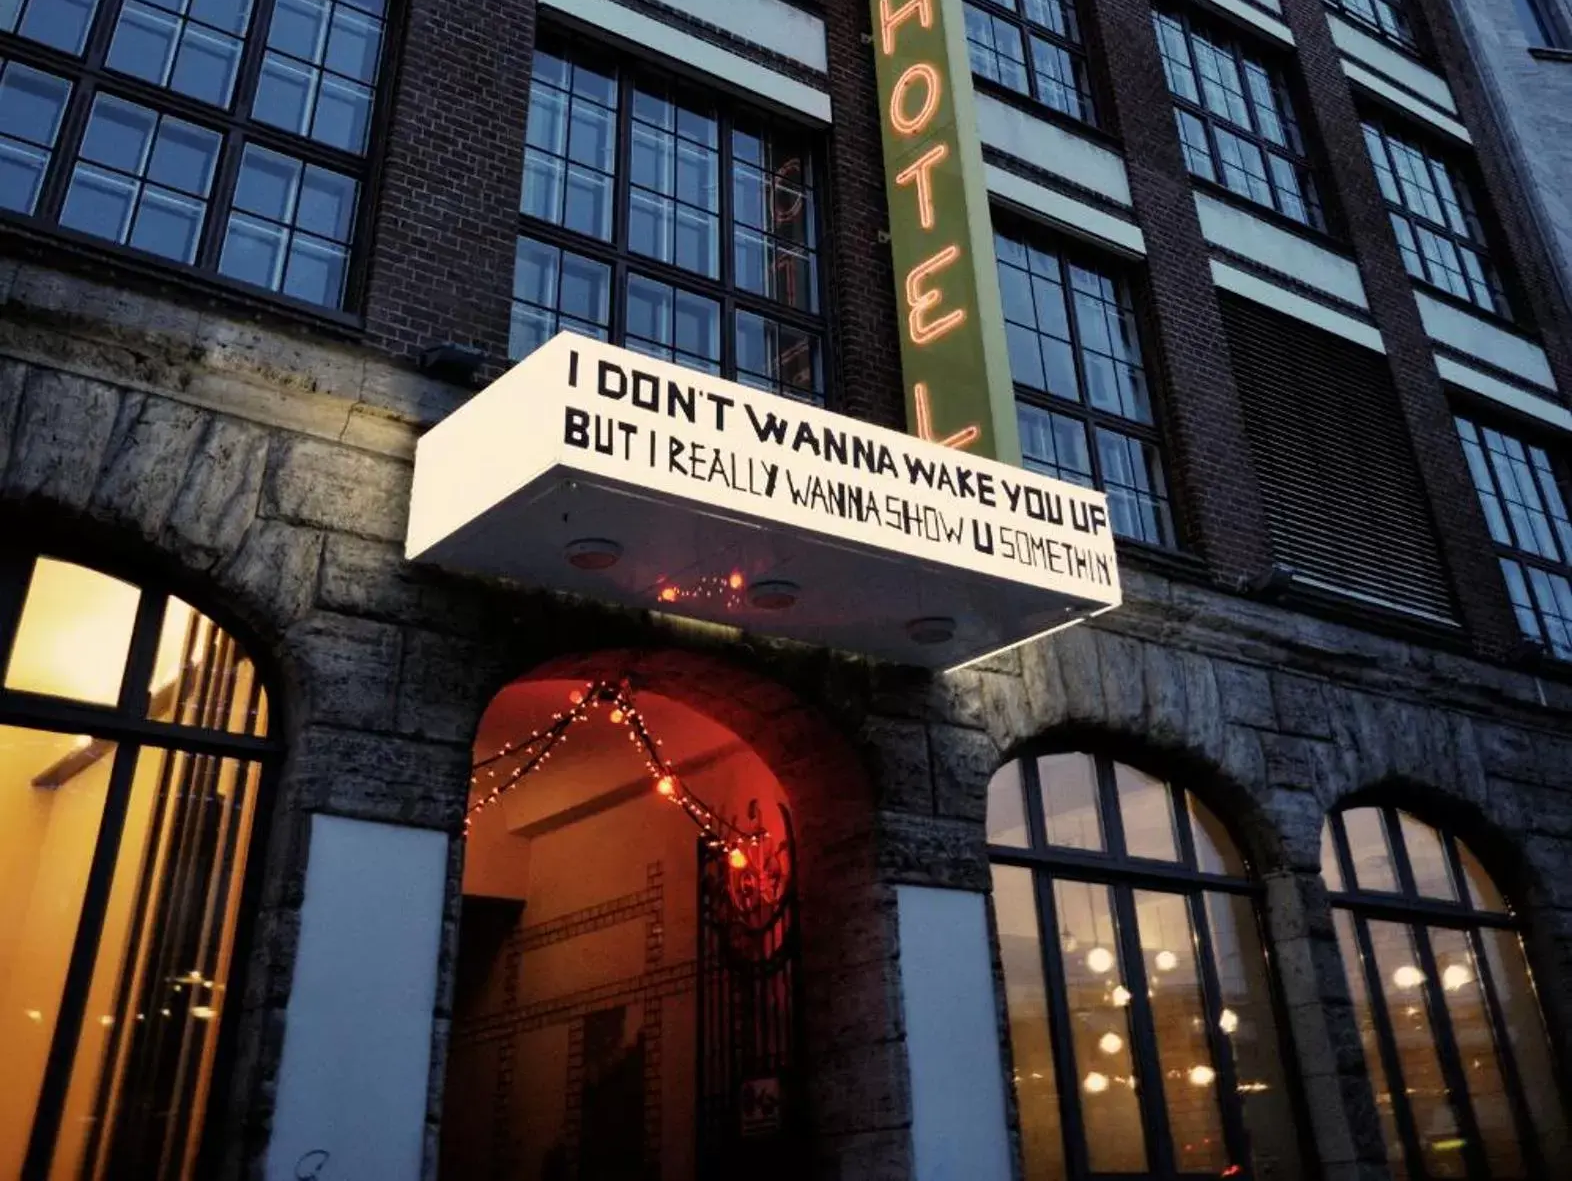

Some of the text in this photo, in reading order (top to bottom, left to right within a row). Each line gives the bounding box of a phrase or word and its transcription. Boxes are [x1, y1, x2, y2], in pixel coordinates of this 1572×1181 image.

[564, 405, 637, 460] BUT
[650, 430, 655, 467] I
[669, 435, 779, 498] REALLY
[786, 469, 882, 527] WANNA
[886, 495, 963, 544] SHOW
[972, 518, 994, 555] U
[568, 350, 1106, 536] I DON'T WANNA WAKE YOU UP
